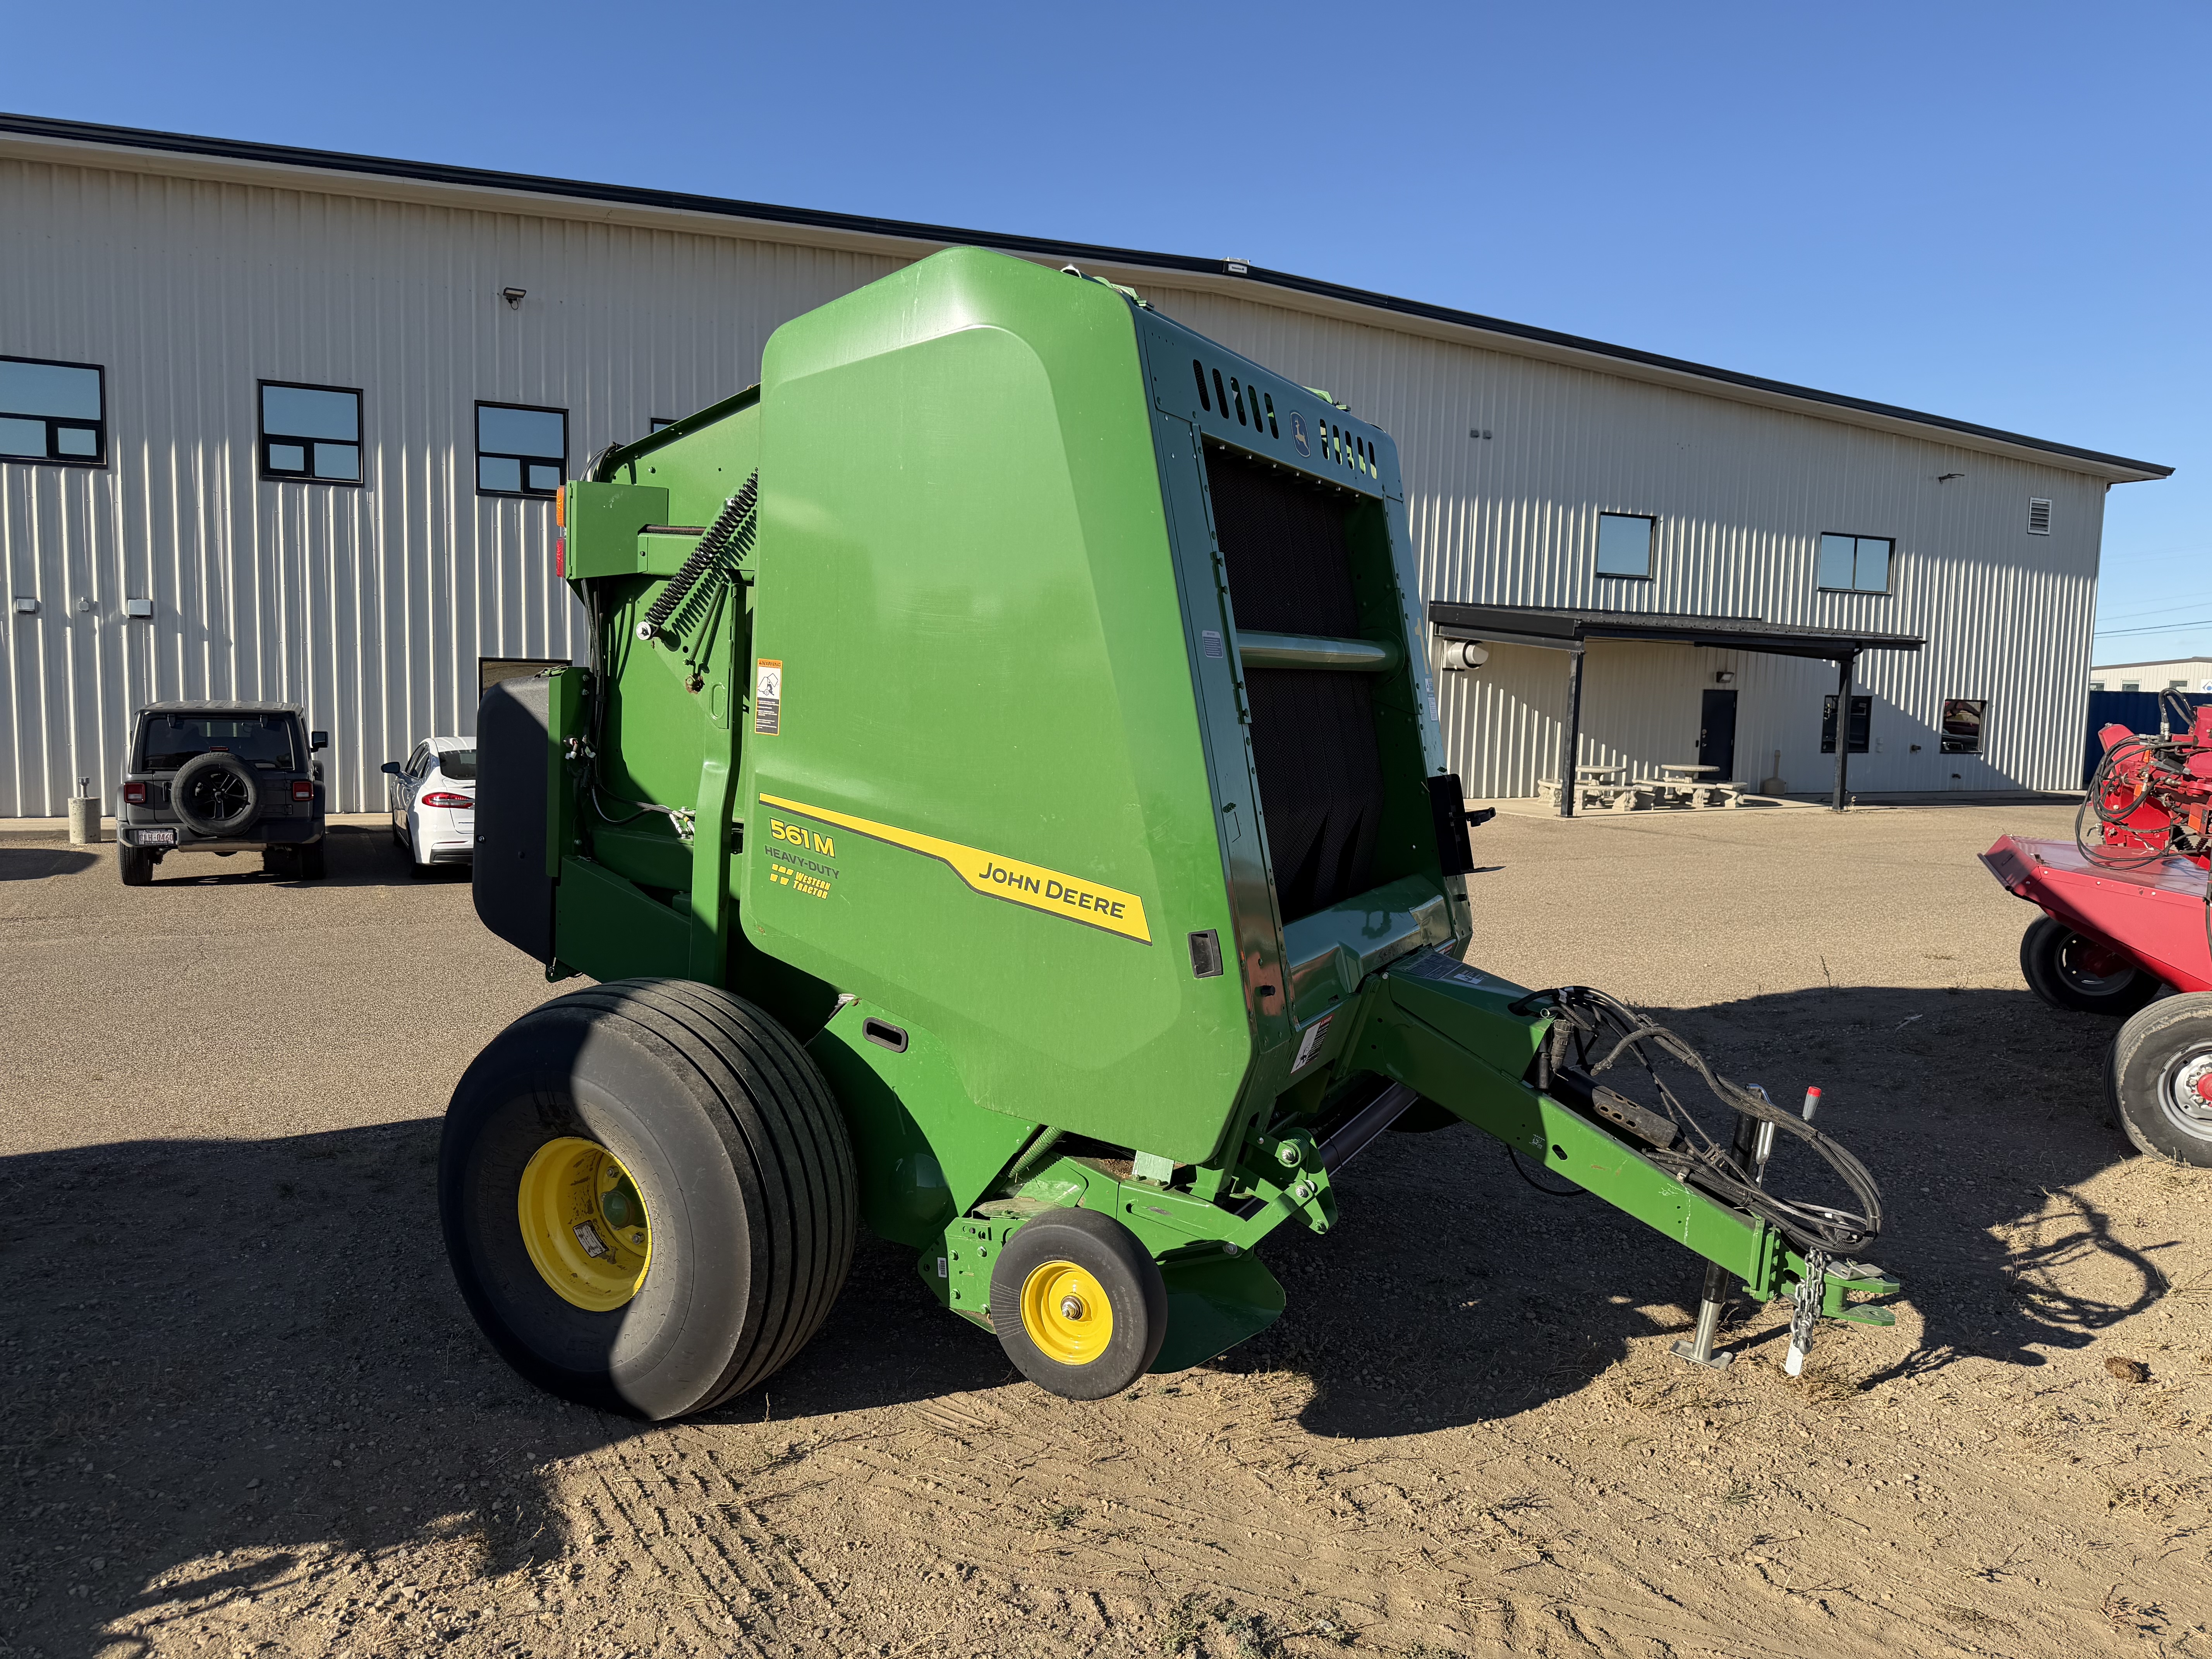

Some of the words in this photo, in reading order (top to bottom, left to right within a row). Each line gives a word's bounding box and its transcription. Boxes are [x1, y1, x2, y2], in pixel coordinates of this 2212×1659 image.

[764, 845, 840, 879] HEAVY-DUTY
[793, 880, 829, 900] TRACTOR
[795, 871, 832, 891] WESTERN
[979, 862, 1041, 894] JOHN
[1045, 879, 1125, 919] DEERE
